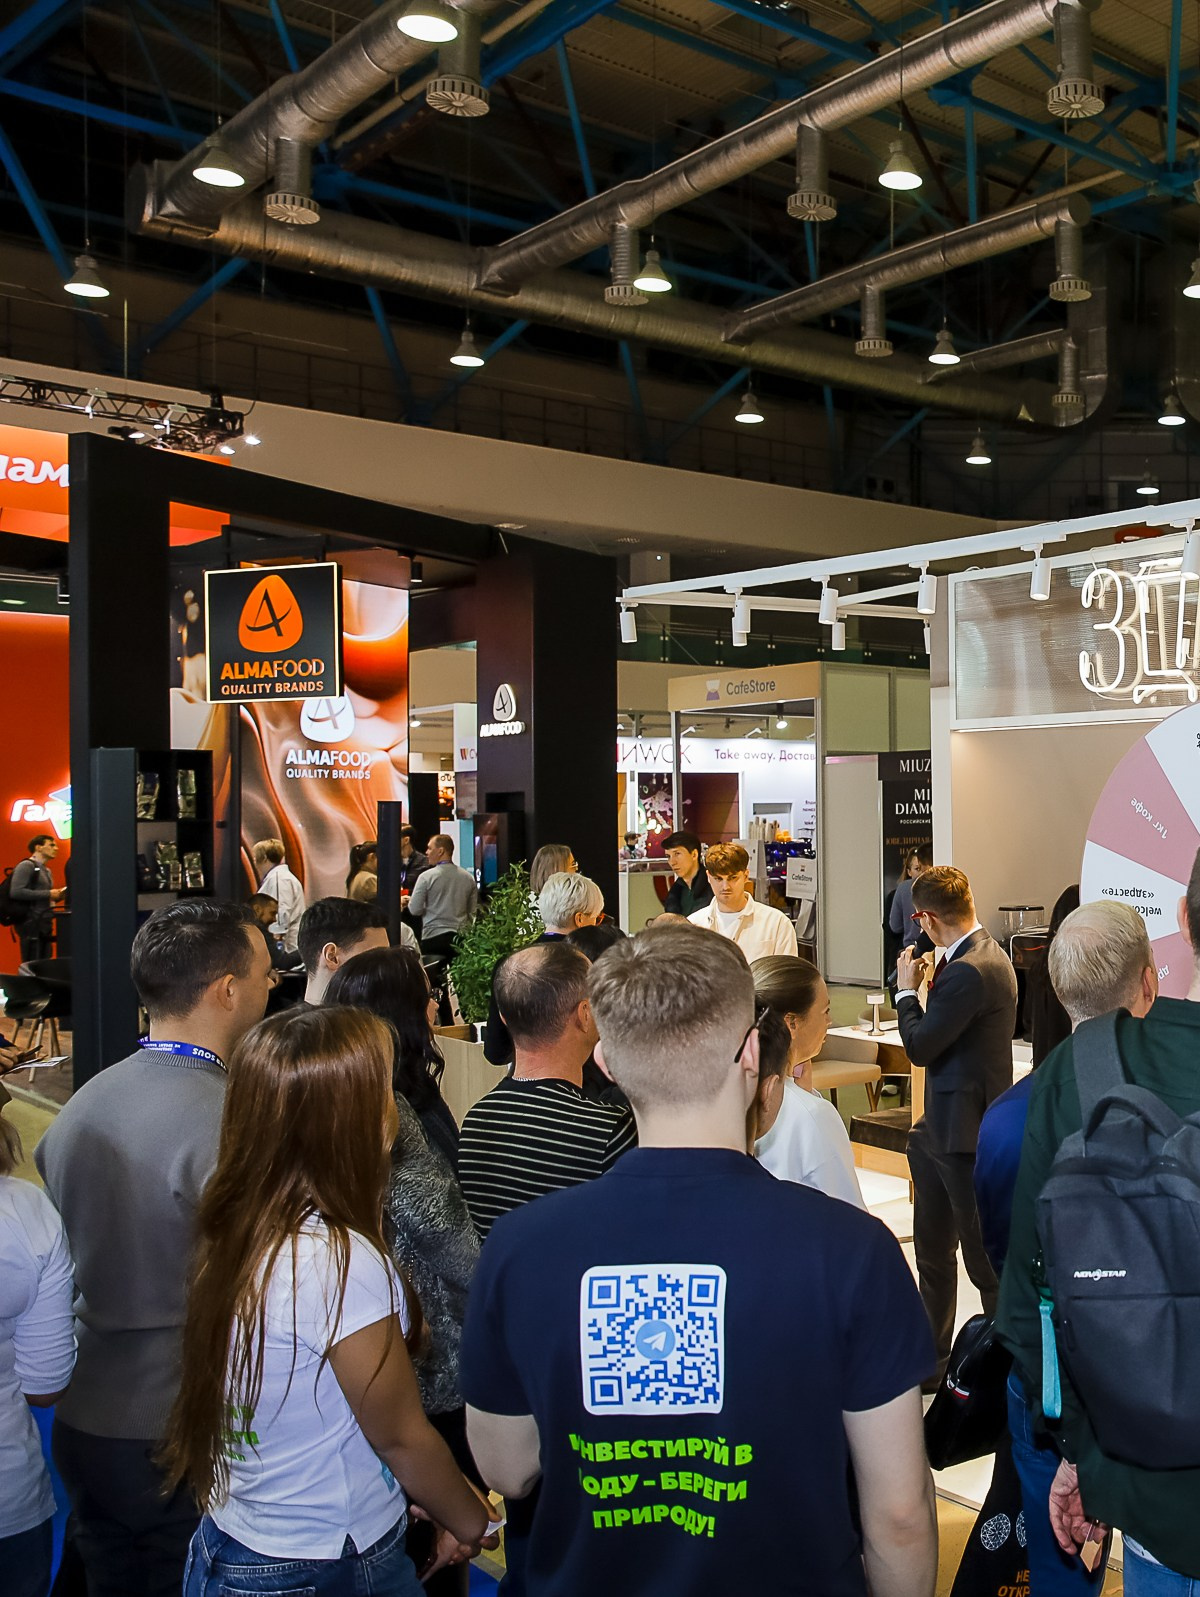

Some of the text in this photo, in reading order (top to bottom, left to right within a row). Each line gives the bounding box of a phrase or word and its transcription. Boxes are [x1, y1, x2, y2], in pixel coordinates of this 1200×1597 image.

[220, 658, 325, 680] ALMAFOOD
[221, 681, 324, 695] QUALITY BRANDS
[726, 680, 776, 696] CafeStore
[480, 721, 525, 738] ALMAFOOD
[285, 748, 371, 767] ALMAFOOD
[617, 743, 692, 765] ИWOK
[715, 748, 740, 760] Take
[743, 752, 777, 764] away.
[900, 758, 932, 773] MIUZ
[286, 768, 371, 780] QUALITY BRANDS
[914, 788, 931, 801] MI
[895, 802, 933, 815] DIAM
[1130, 797, 1168, 839] 1кг кофе
[1101, 887, 1155, 899] «здрасте»
[1133, 905, 1162, 917] welco
[1157, 965, 1170, 982] др
[734, 1445, 753, 1467] В
[579, 1468, 639, 1499] ОДУ
[660, 1471, 747, 1502] БЕРЕГИ
[593, 1504, 716, 1539] ПРИРОДУ!
[997, 1585, 1031, 1597] ОТКР
